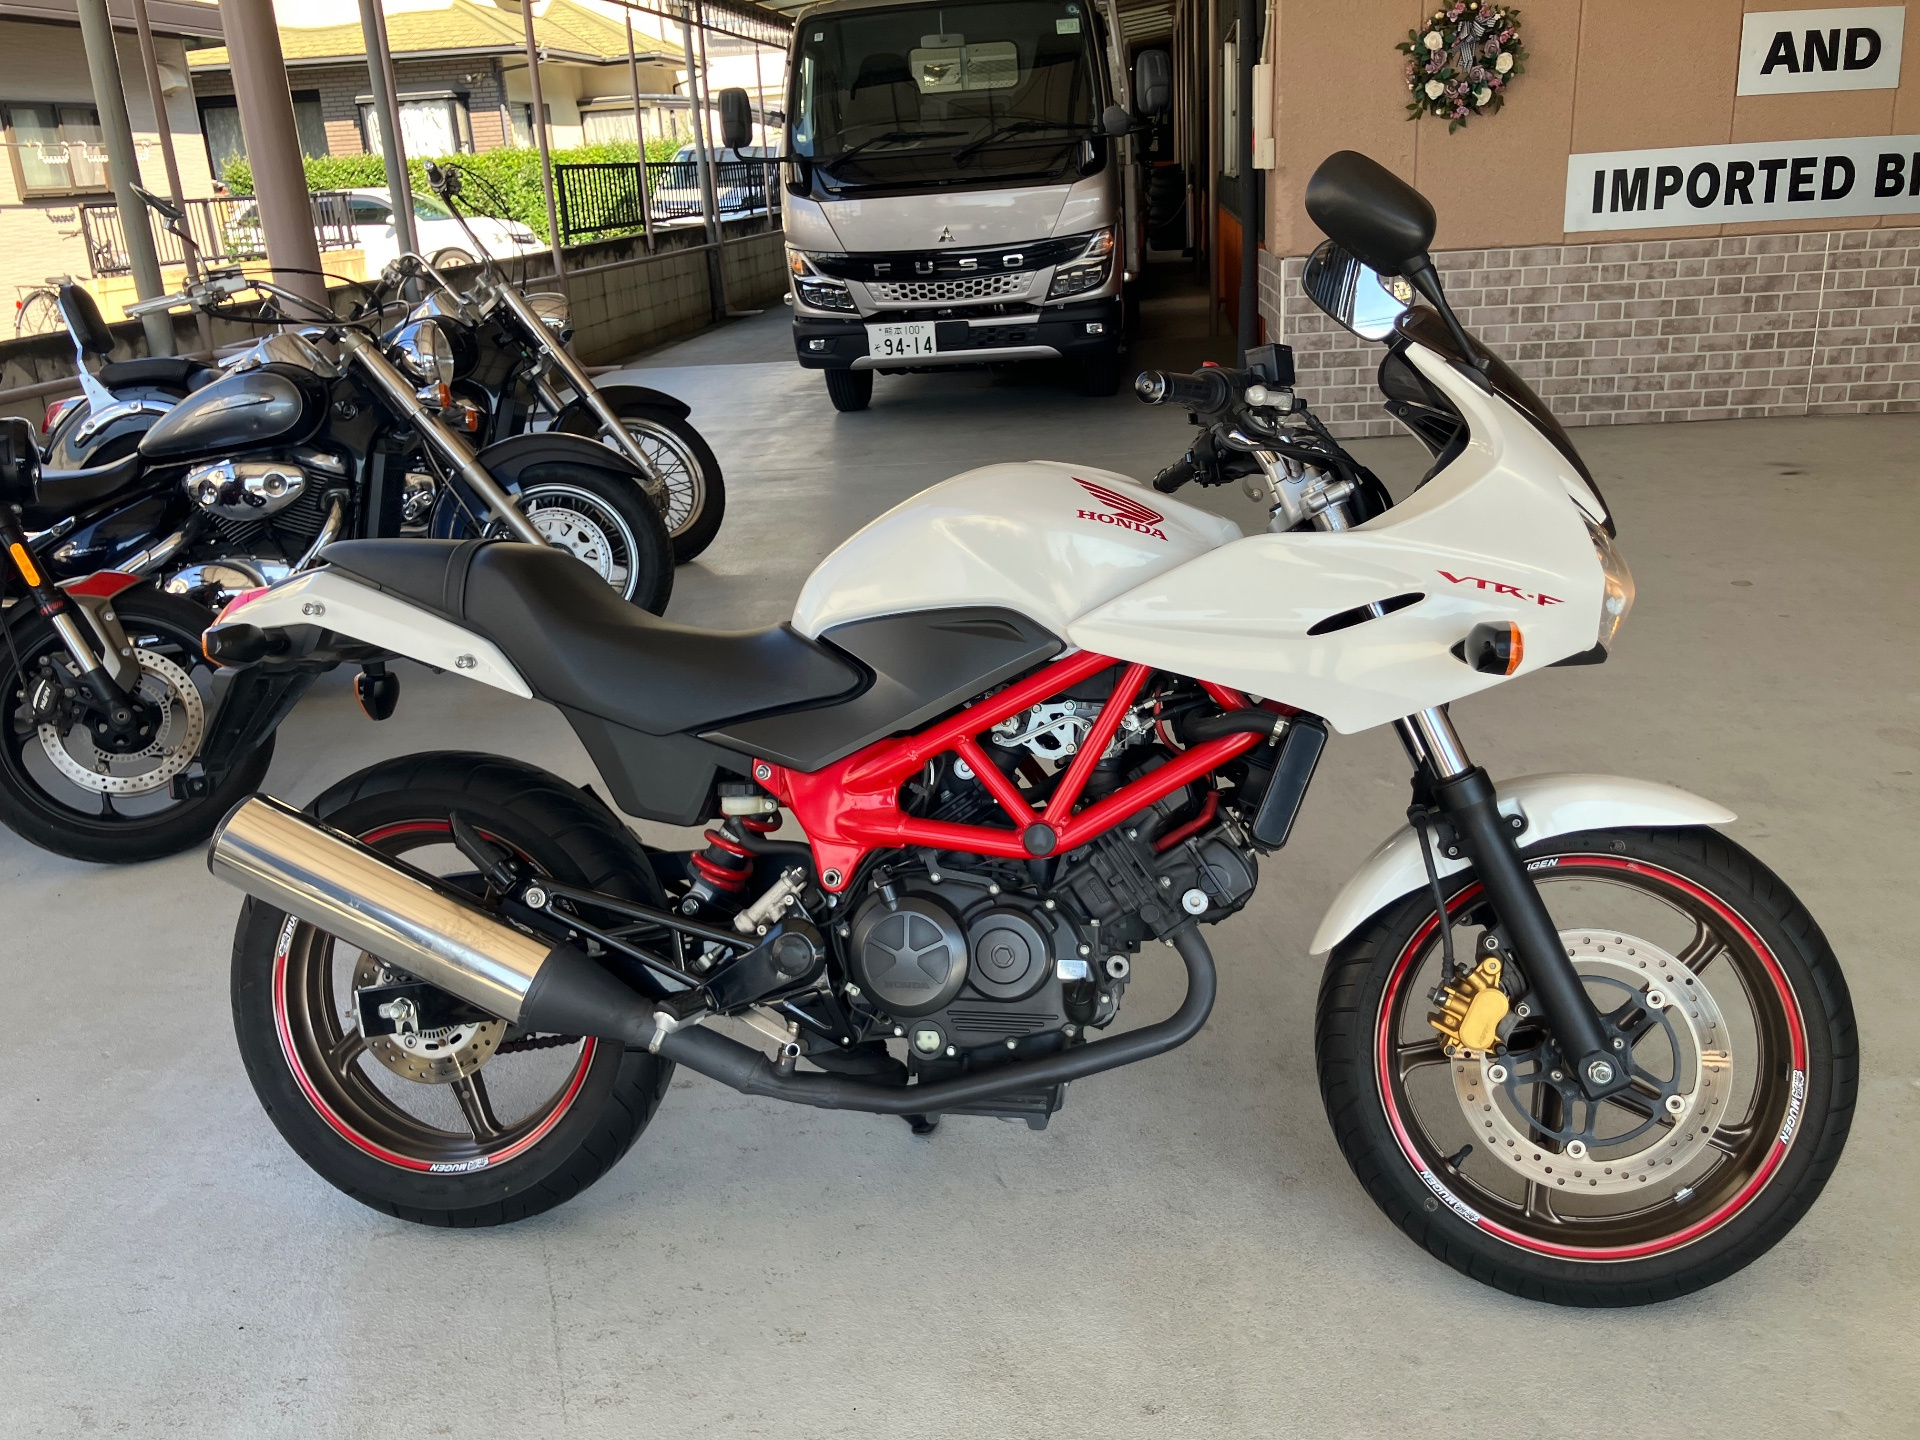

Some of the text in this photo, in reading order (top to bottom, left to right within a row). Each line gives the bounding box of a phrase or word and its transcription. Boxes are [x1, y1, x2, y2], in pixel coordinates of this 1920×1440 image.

[1760, 27, 1882, 75] AND
[1591, 155, 1856, 214] IMPORTED
[873, 253, 1024, 277] FUSO
[1076, 509, 1169, 541] HONDA
[1779, 1097, 1801, 1145] MUGEN
[429, 1162, 468, 1172] MUGEN
[1420, 1170, 1457, 1205] MUGEN
